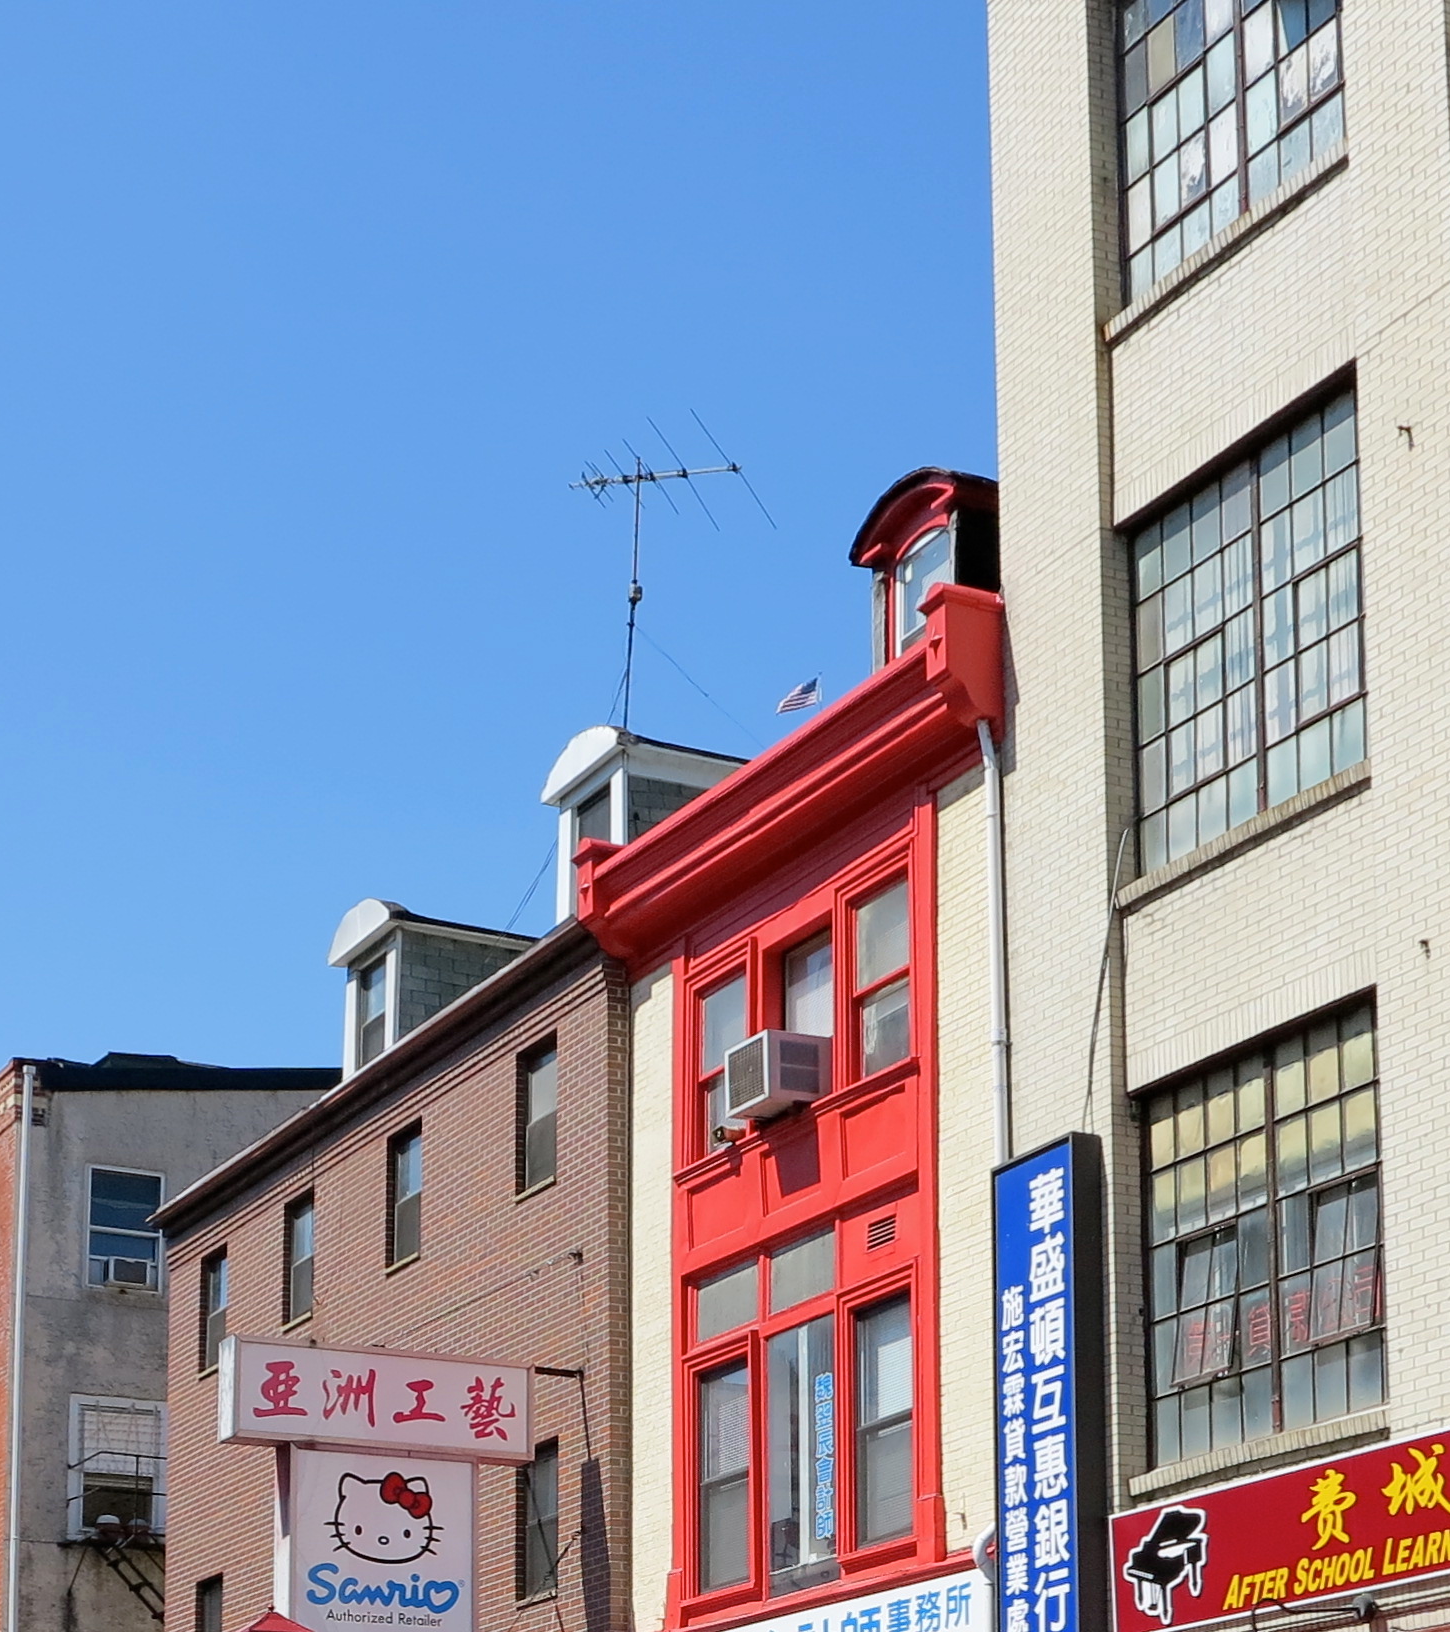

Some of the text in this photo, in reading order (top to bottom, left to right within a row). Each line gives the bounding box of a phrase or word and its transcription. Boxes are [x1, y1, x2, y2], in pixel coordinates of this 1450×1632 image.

[252, 1360, 517, 1441] 亞洲工藝
[306, 1562, 460, 1614] Sanrio
[1222, 1573, 1286, 1612] AFTER
[1295, 1549, 1375, 1596] SCHOOL
[326, 1608, 443, 1628] Authorized Retailer
